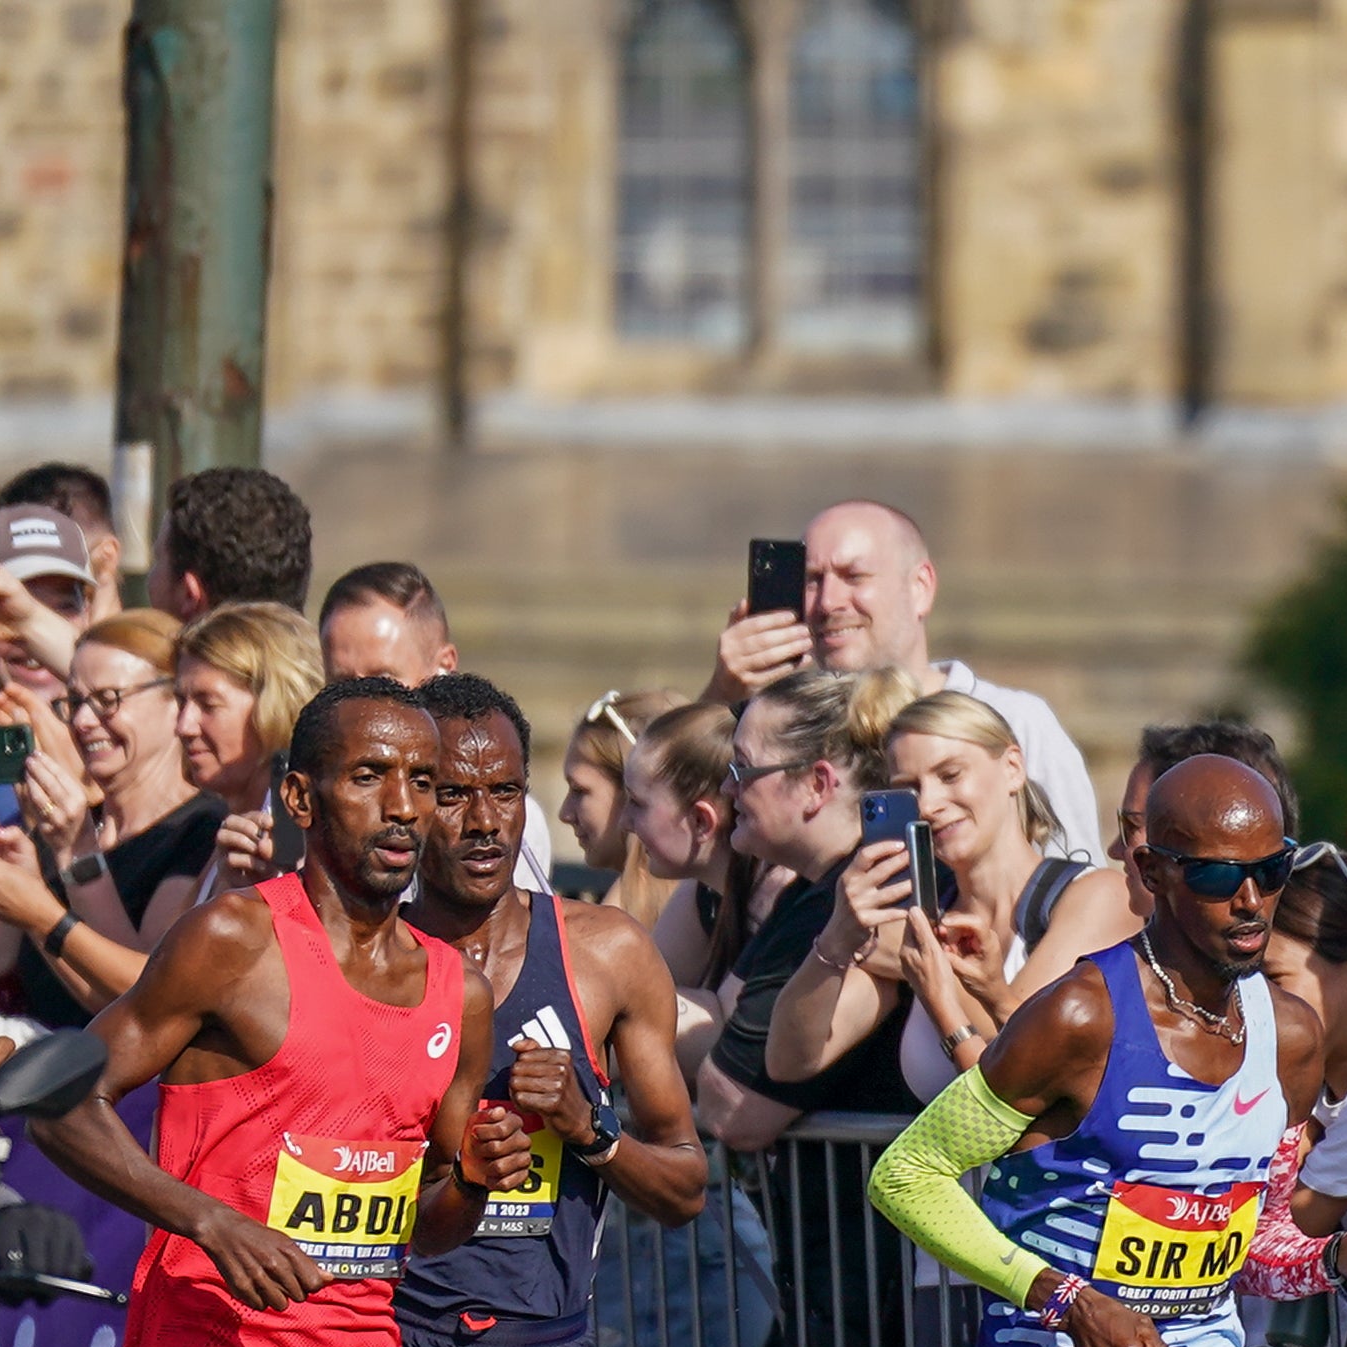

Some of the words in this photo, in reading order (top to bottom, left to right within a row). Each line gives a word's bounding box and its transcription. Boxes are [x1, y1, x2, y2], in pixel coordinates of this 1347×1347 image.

[285, 1191, 407, 1235] ABDI
[500, 1204, 530, 1216] 2023
[501, 1221, 523, 1232] M&S
[1115, 1236, 1188, 1279] SIR
[1198, 1231, 1243, 1278] MO
[1117, 1285, 1152, 1299] GREAT
[1153, 1288, 1188, 1300] NORTH
[1189, 1287, 1210, 1299] RUN
